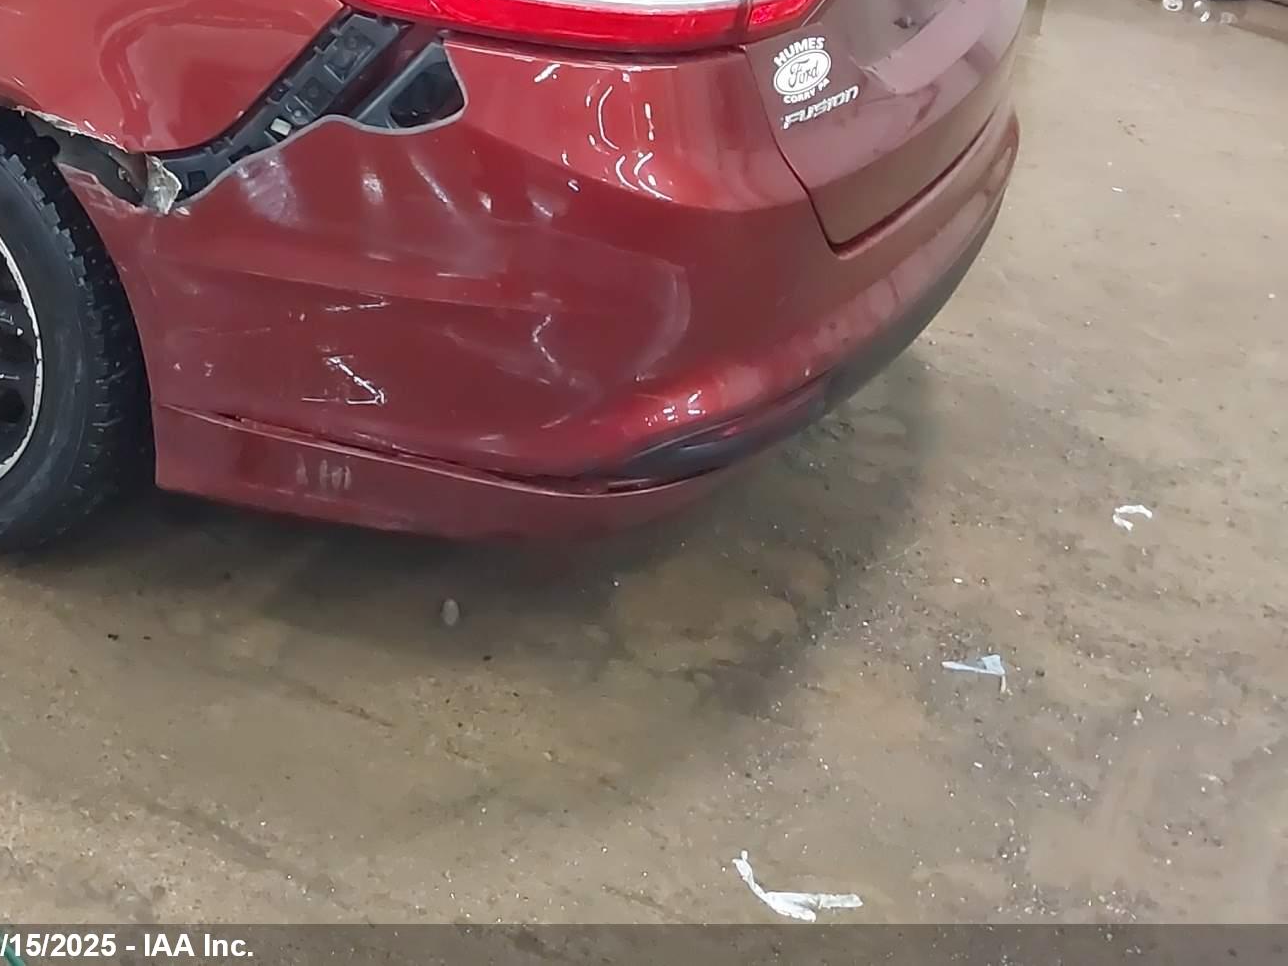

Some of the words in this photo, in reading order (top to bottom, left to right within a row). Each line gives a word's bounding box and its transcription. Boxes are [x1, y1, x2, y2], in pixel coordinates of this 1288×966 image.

[773, 37, 825, 68] HUMES
[787, 57, 819, 89] Ford
[783, 88, 816, 104] CORRY
[818, 77, 831, 92] PA
